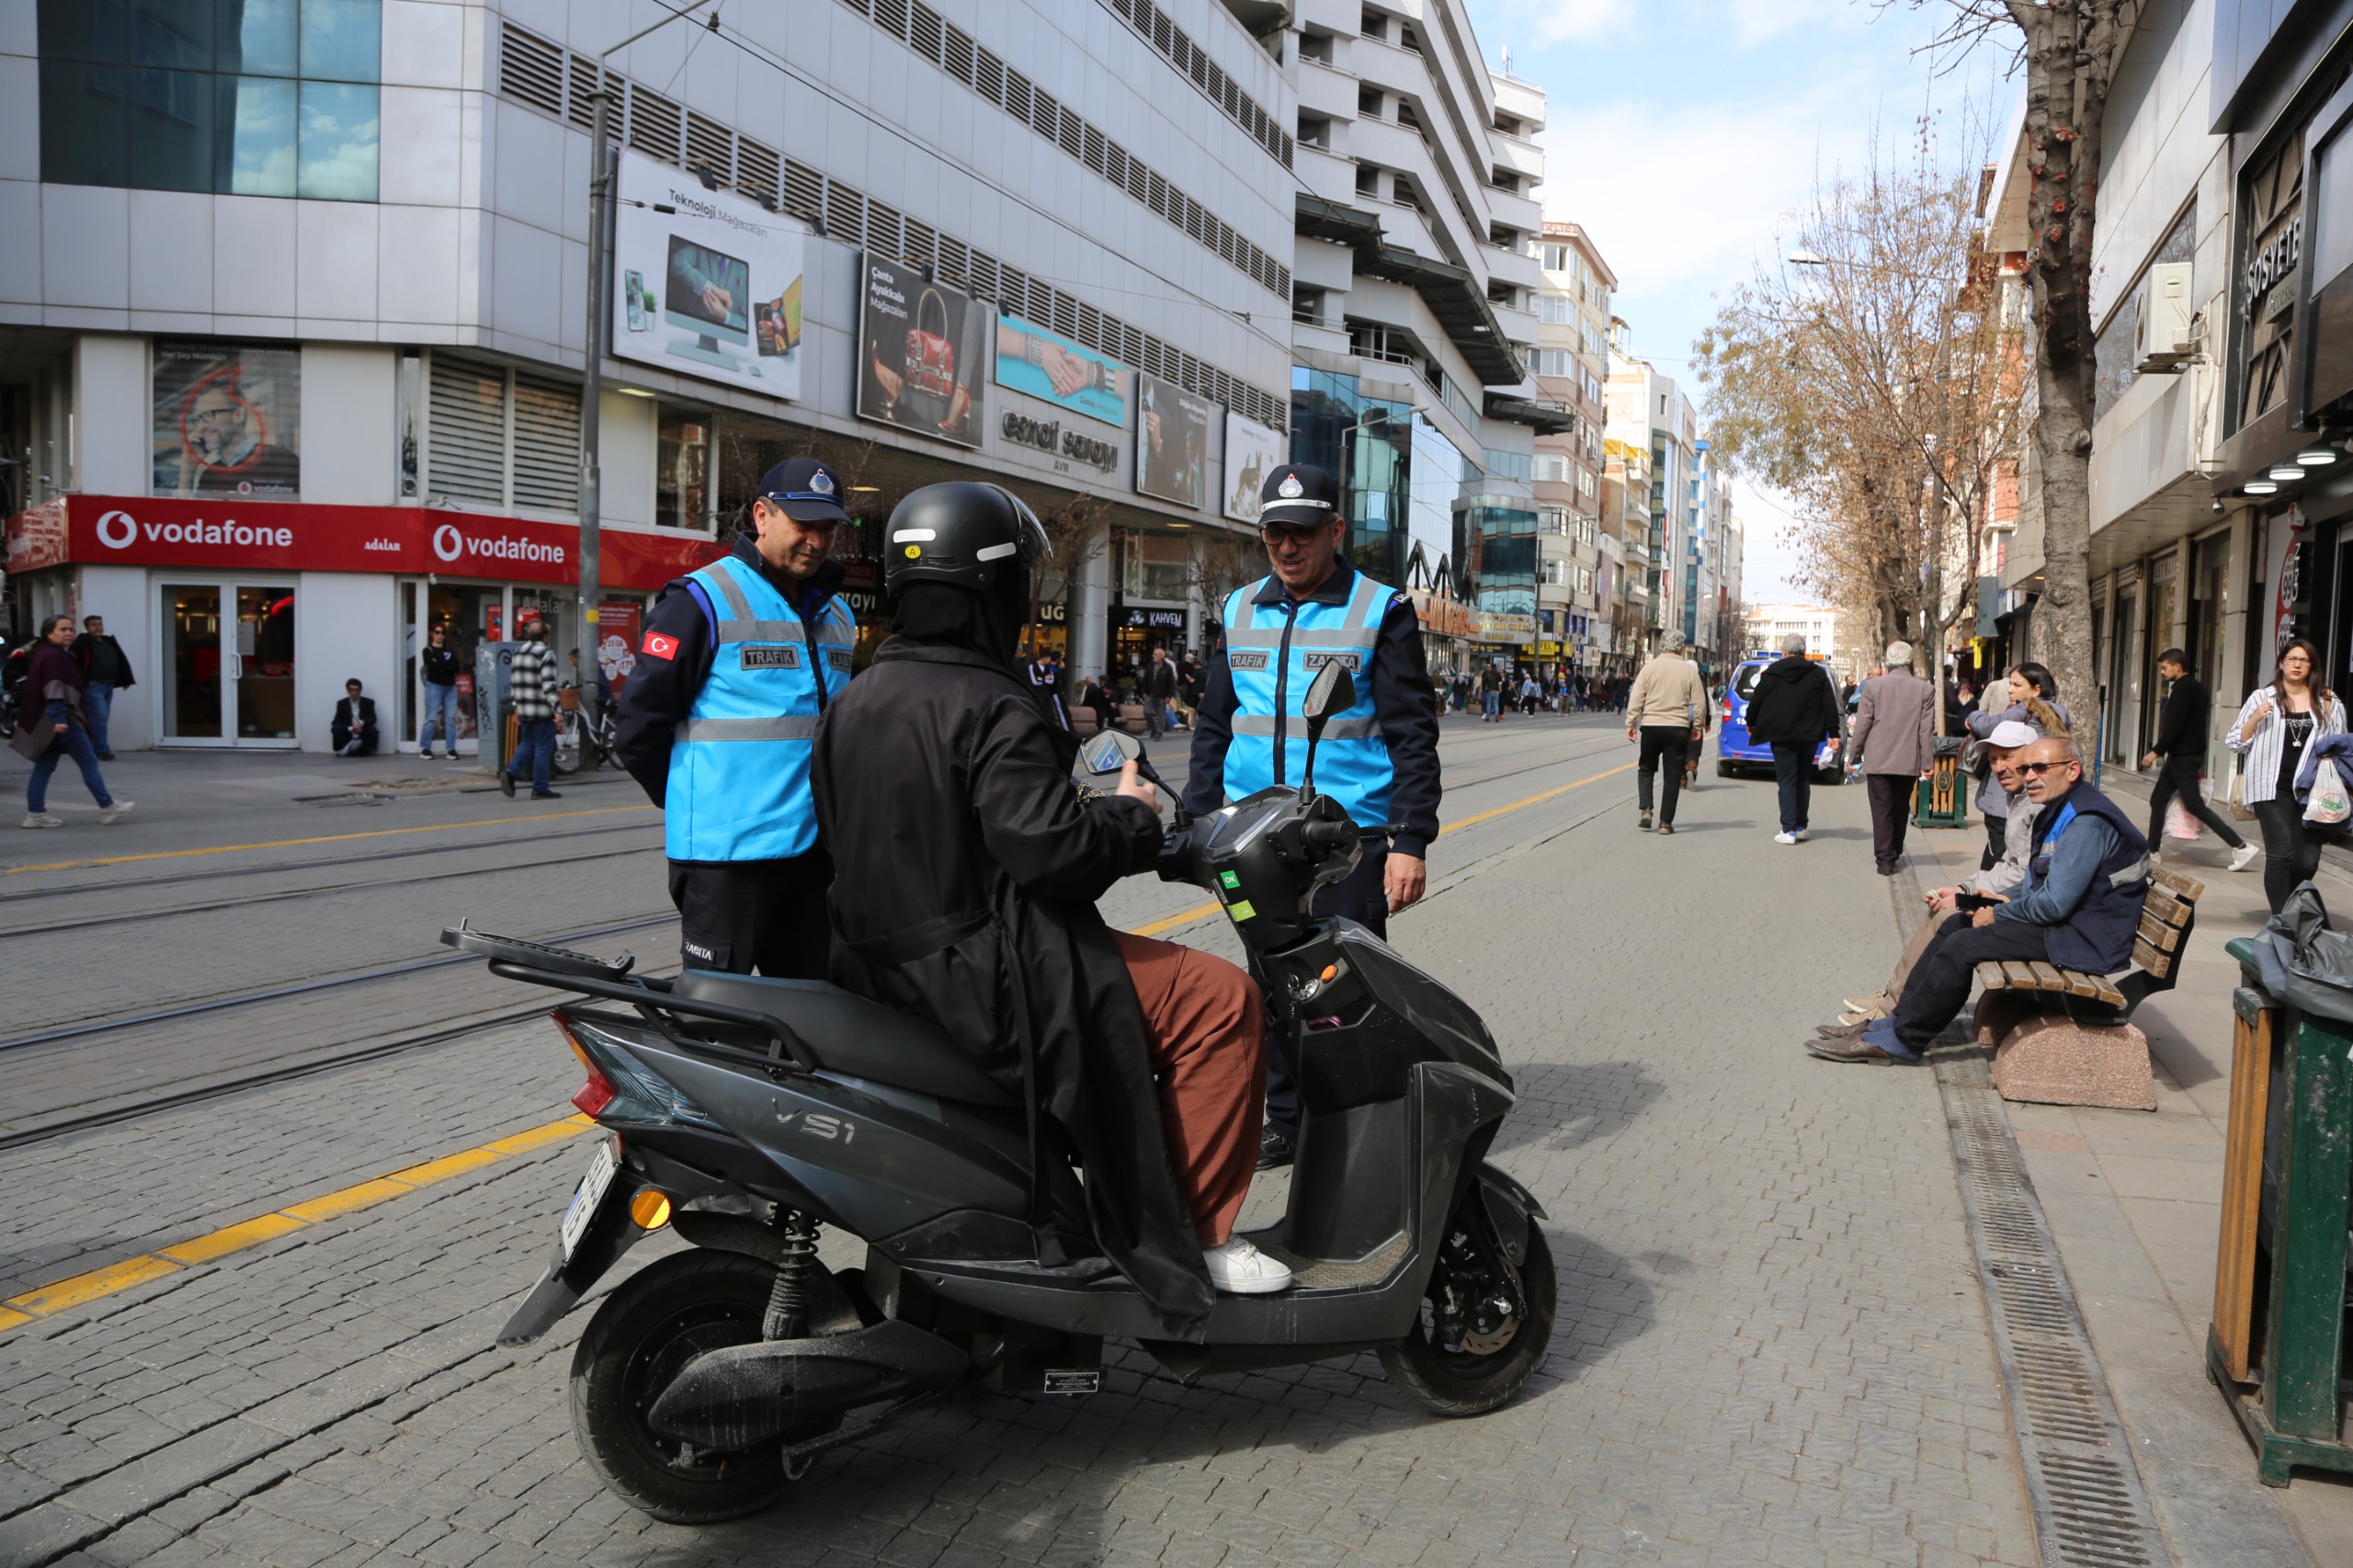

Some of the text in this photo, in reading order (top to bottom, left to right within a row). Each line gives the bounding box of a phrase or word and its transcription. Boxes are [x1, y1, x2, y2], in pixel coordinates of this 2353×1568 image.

[669, 188, 716, 219] Teknoloji
[871, 266, 893, 284] Çanta
[870, 281, 905, 304] Ayakkabı
[1053, 460, 1069, 472] AVM
[254, 483, 293, 494] vodafone
[143, 518, 293, 547] vodafone
[466, 535, 565, 563] vodafone
[909, 548, 916, 556] A
[522, 596, 565, 614] Adalar
[1150, 611, 1182, 627] KAHVEM
[1224, 876, 1236, 884] OK
[771, 1097, 855, 1144] VS1
